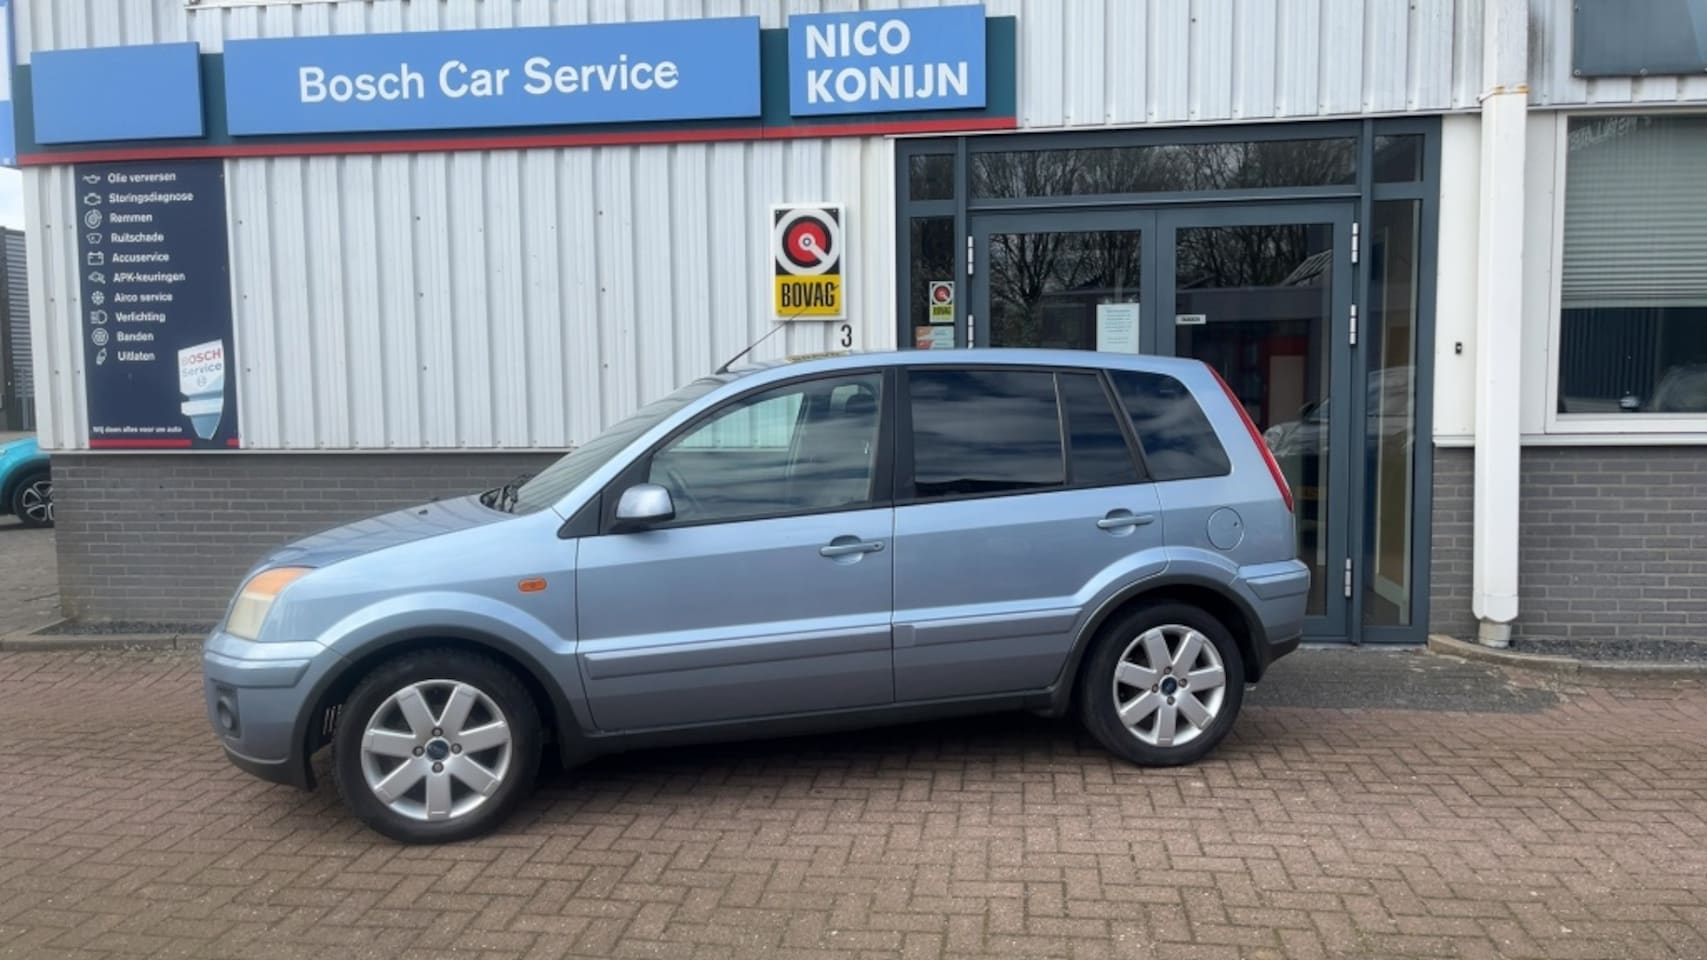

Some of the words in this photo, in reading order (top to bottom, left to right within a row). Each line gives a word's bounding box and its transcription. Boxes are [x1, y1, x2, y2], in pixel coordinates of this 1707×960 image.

[806, 19, 911, 59] NICO
[299, 63, 425, 103] Bosch
[439, 60, 510, 98] Car
[524, 54, 679, 95] Service
[807, 62, 969, 103] KONIJN
[107, 172, 128, 184] Olie
[129, 173, 177, 183] verversen
[108, 191, 194, 205] Storingsdiagnose
[109, 212, 153, 224] Remmen
[110, 232, 165, 243] Ruitschade
[112, 252, 170, 263] Accuservice
[113, 272, 186, 284] APK-keuringen
[114, 292, 138, 303] Airco
[139, 292, 174, 303] service
[781, 281, 835, 308] BOVAG
[115, 310, 167, 323] Verlichting
[117, 331, 154, 342] Banden
[840, 324, 853, 348] 3
[118, 351, 156, 362] Uitlaten
[182, 347, 222, 366] BOSCH
[182, 362, 222, 377] Service
